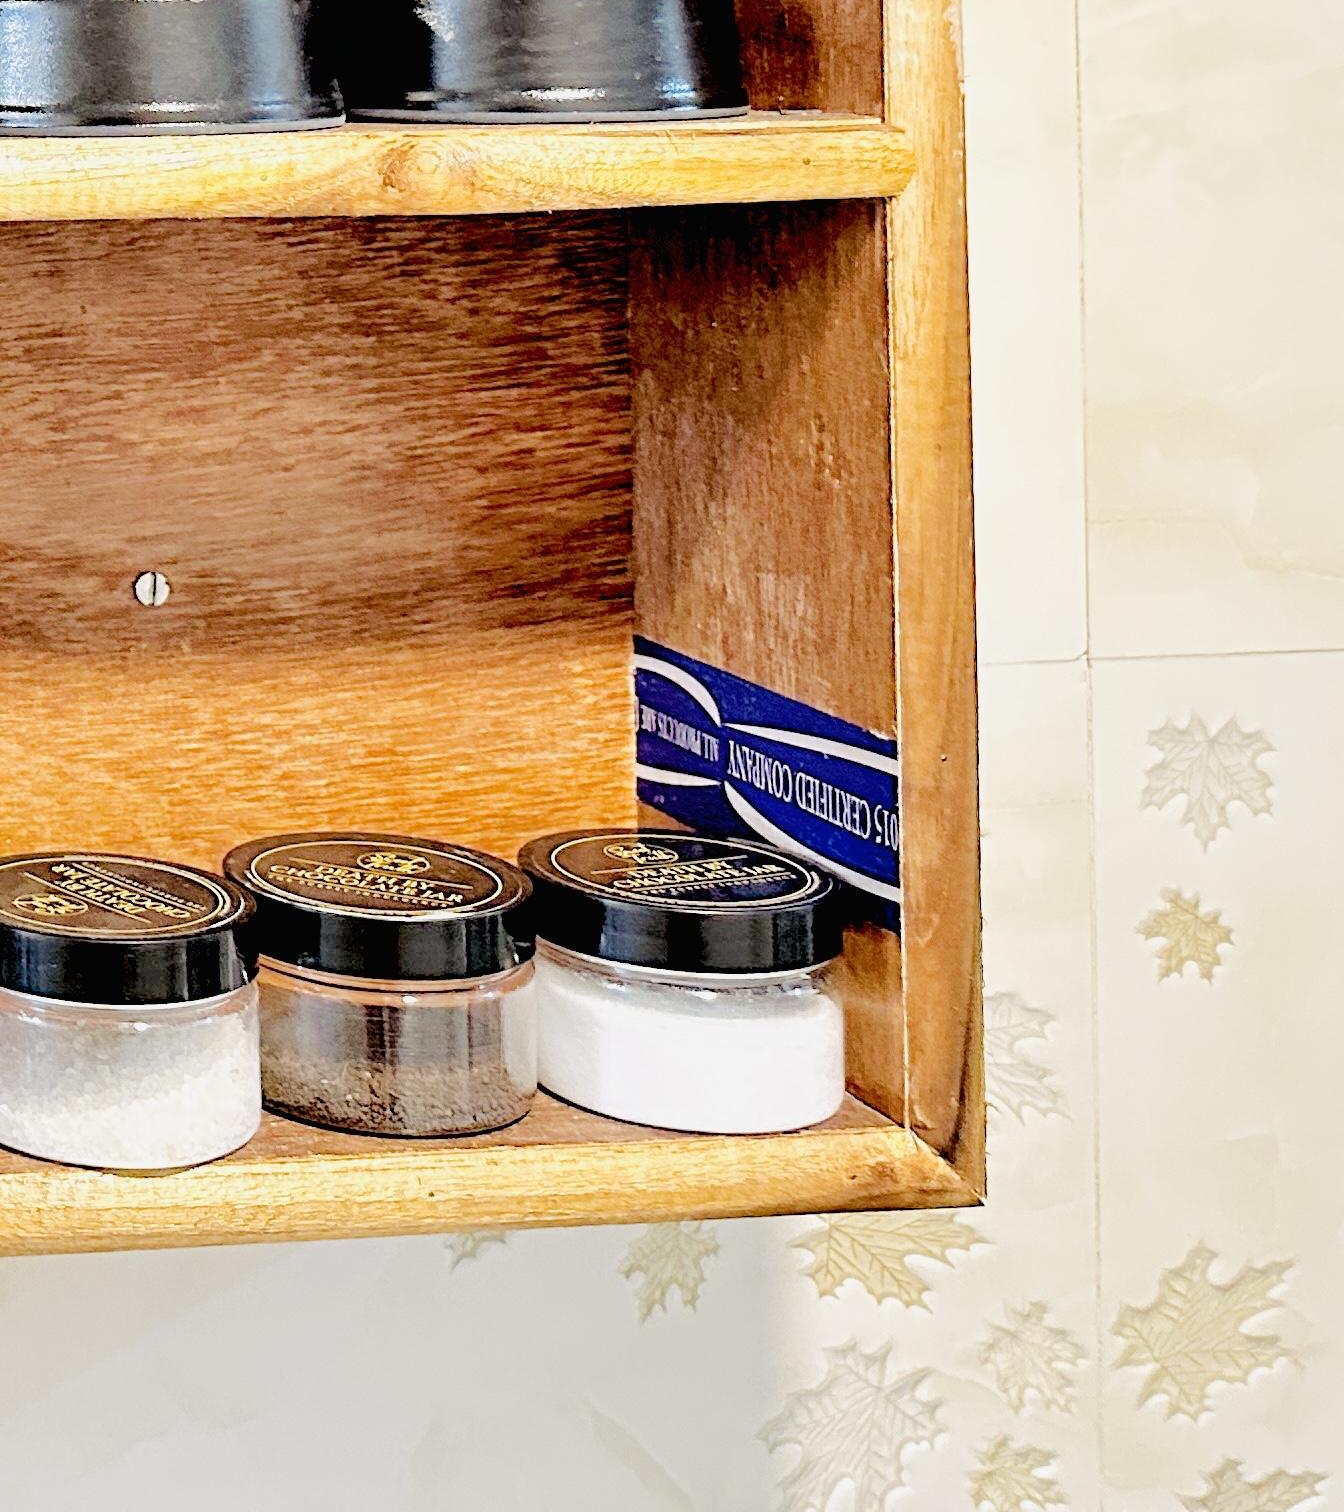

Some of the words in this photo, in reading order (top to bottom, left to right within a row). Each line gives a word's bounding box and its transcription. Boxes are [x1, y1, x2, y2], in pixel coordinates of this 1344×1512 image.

[727, 739, 793, 803] COMPANY
[795, 772, 871, 840] CERTIFIED
[270, 864, 419, 896] CHOCOLATE
